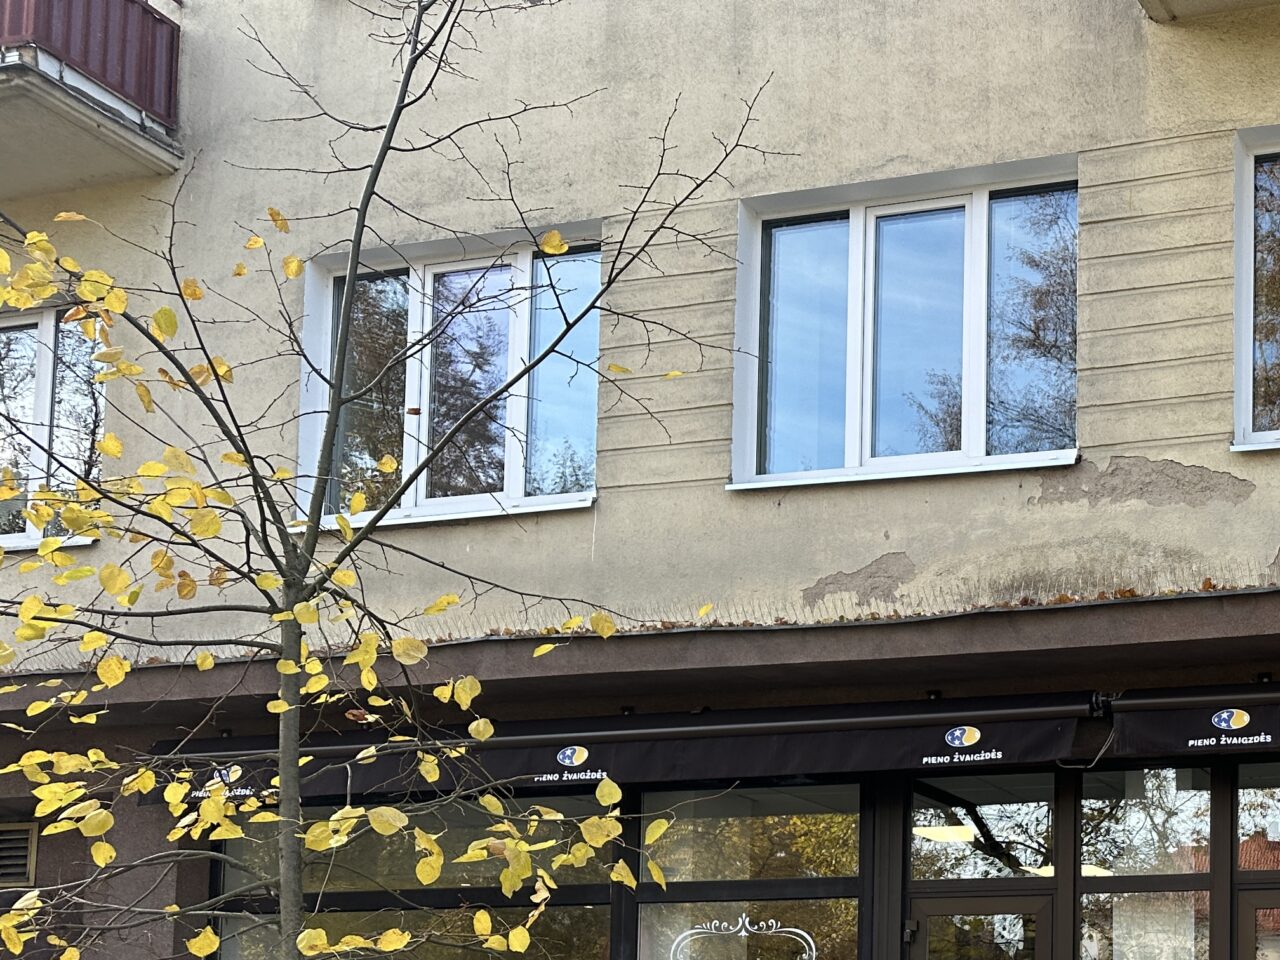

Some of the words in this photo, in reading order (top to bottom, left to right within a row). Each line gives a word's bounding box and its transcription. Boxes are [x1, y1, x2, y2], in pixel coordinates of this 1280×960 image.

[1188, 737, 1217, 747] PIENO
[922, 755, 951, 764] PIENO
[953, 749, 1003, 762] ŽVAIGŽDĖS
